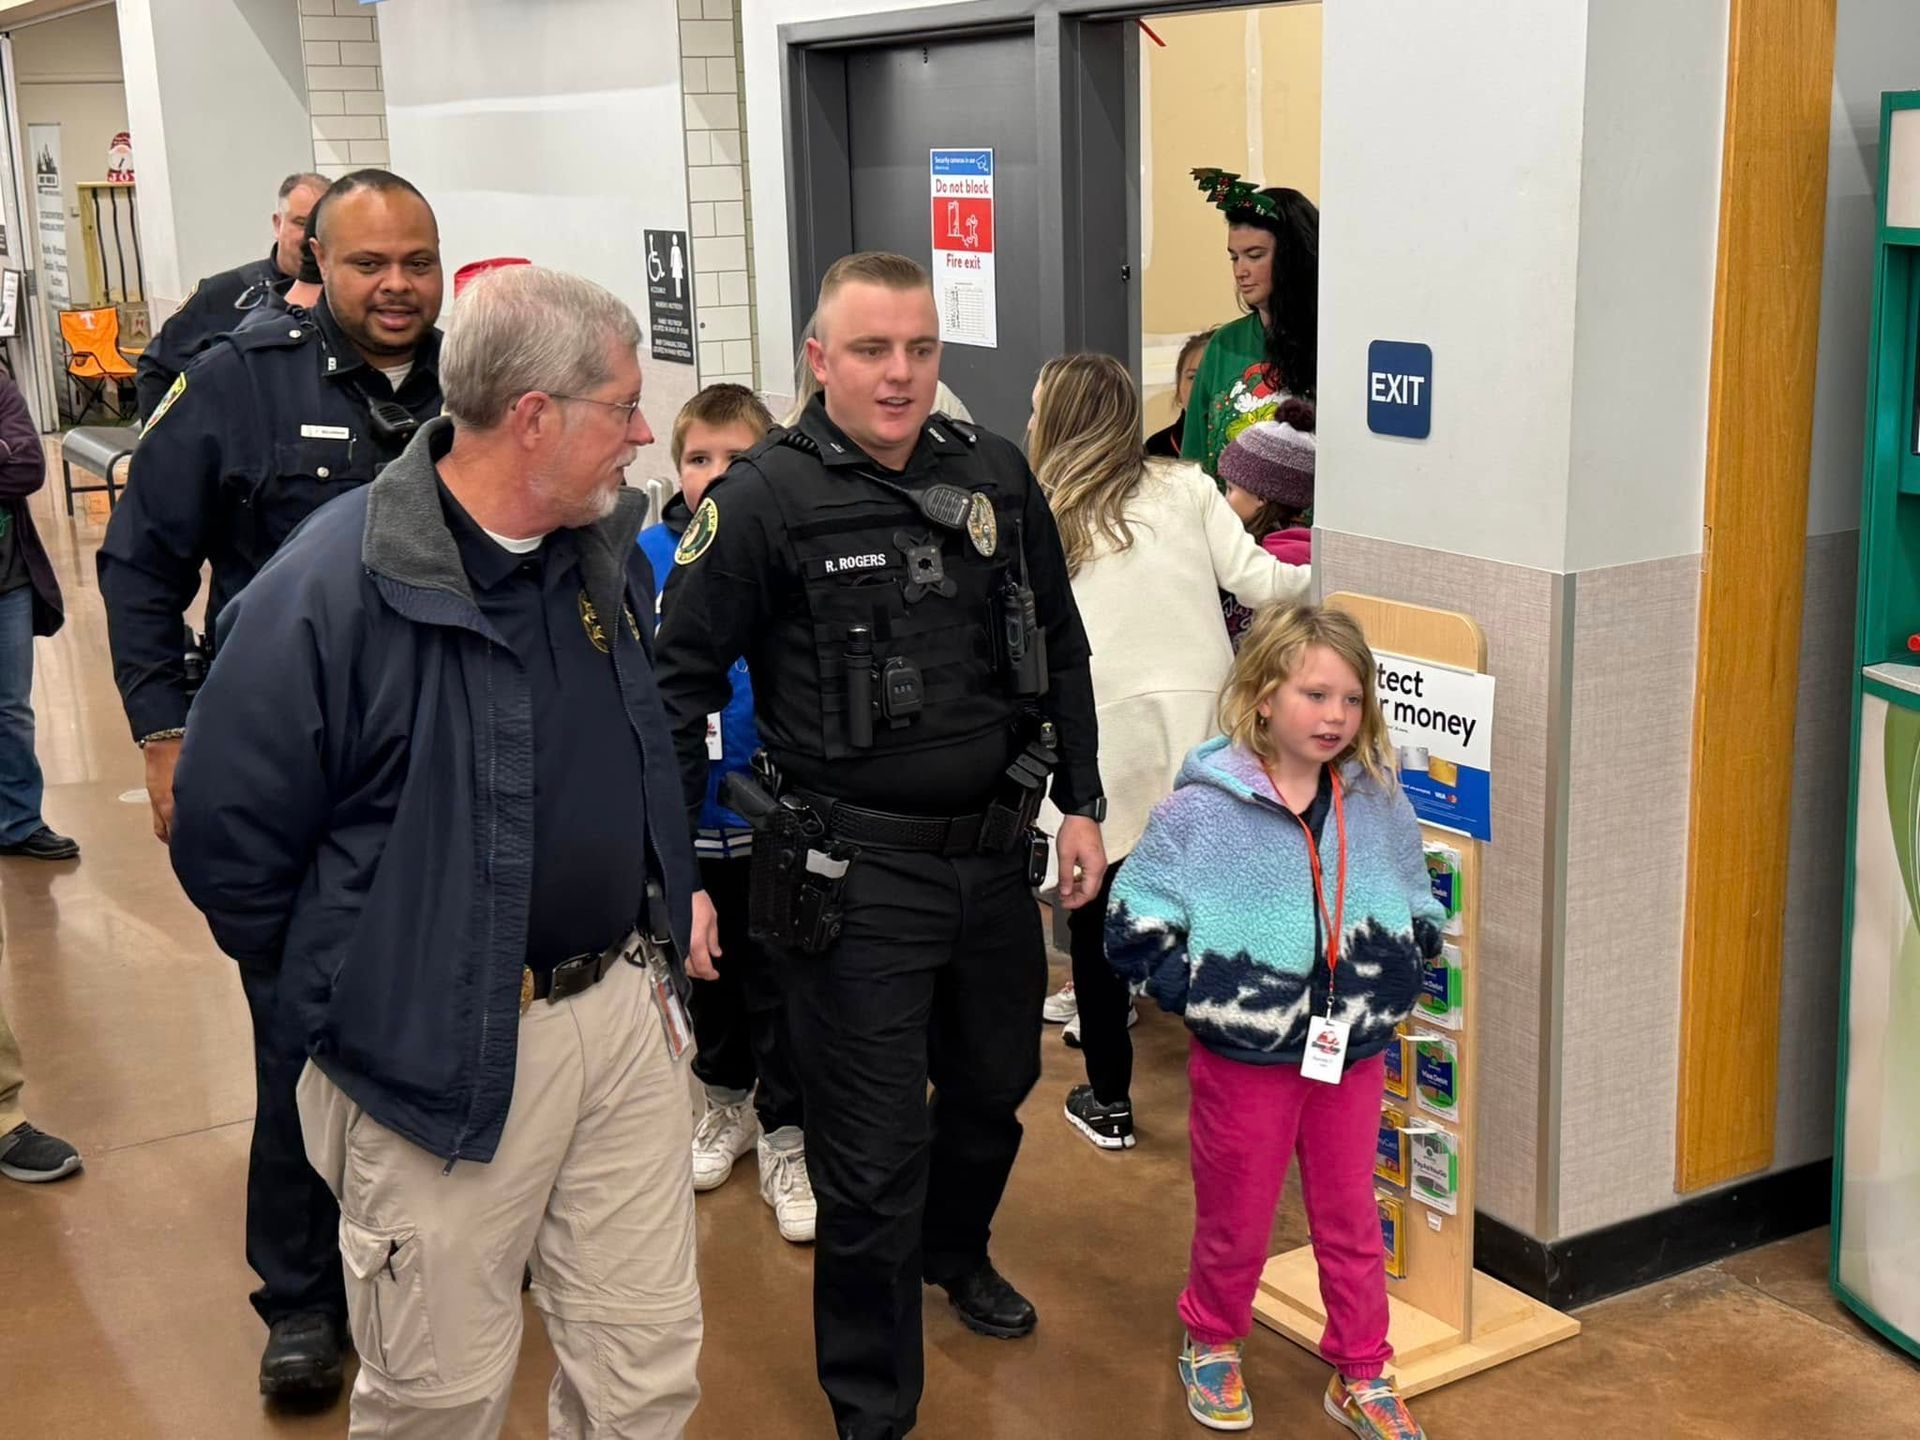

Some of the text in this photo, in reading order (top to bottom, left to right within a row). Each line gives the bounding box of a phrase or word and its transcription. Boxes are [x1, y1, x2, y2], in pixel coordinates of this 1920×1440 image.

[935, 178, 989, 194] Do not block
[946, 253, 981, 270] Fire exit
[1371, 371, 1425, 406] EXIT
[825, 553, 887, 573] R. ROGERS
[1377, 663, 1424, 698] tect
[1394, 701, 1477, 747] money
